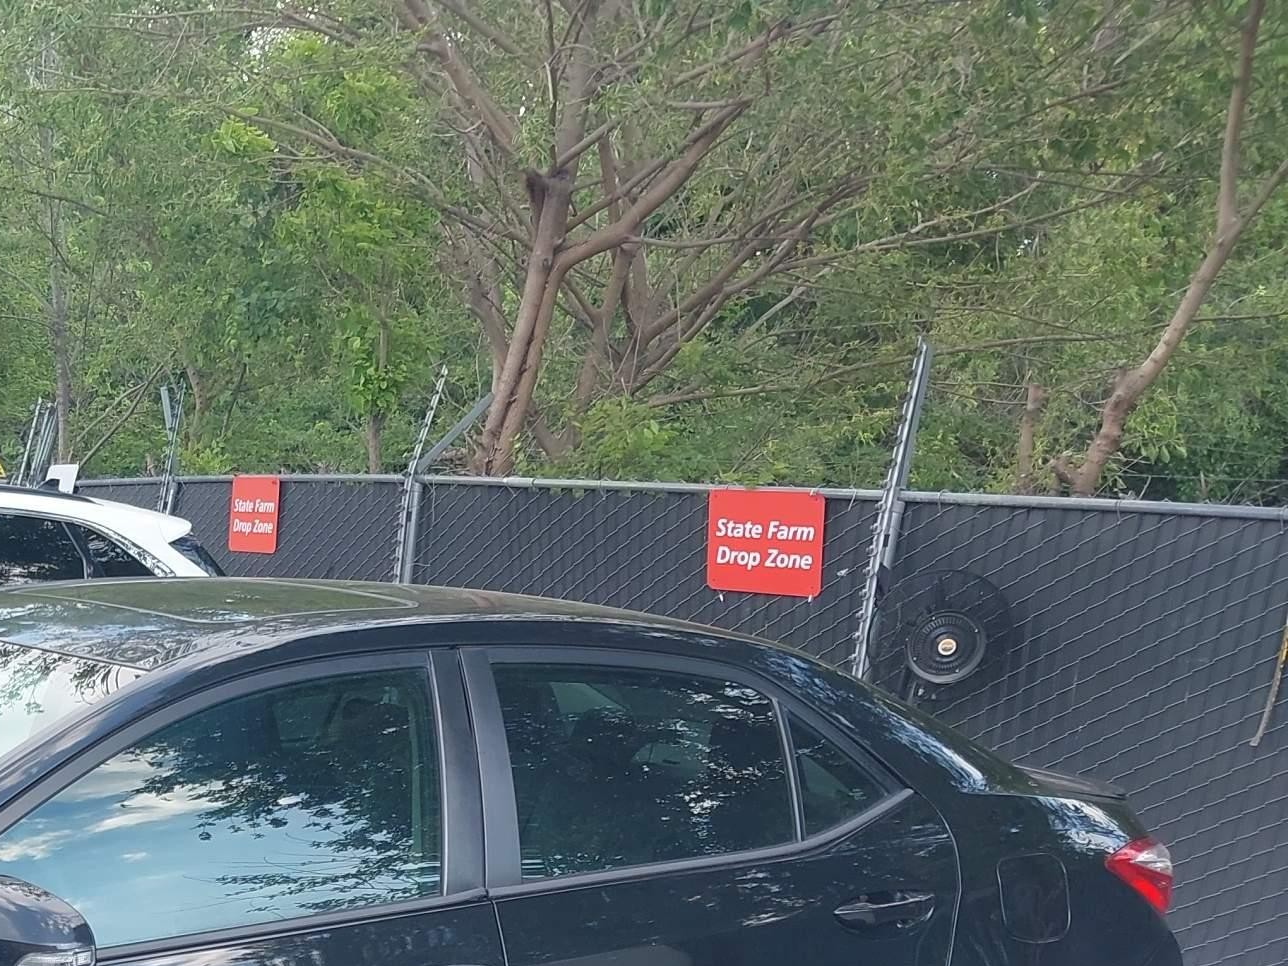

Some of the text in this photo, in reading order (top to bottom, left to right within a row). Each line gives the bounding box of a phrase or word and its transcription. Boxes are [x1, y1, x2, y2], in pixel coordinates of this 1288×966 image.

[233, 499, 275, 513] State Farm
[233, 519, 274, 536] Drop Zone
[715, 518, 815, 541] State Farm
[716, 545, 813, 571] Drop Zone
